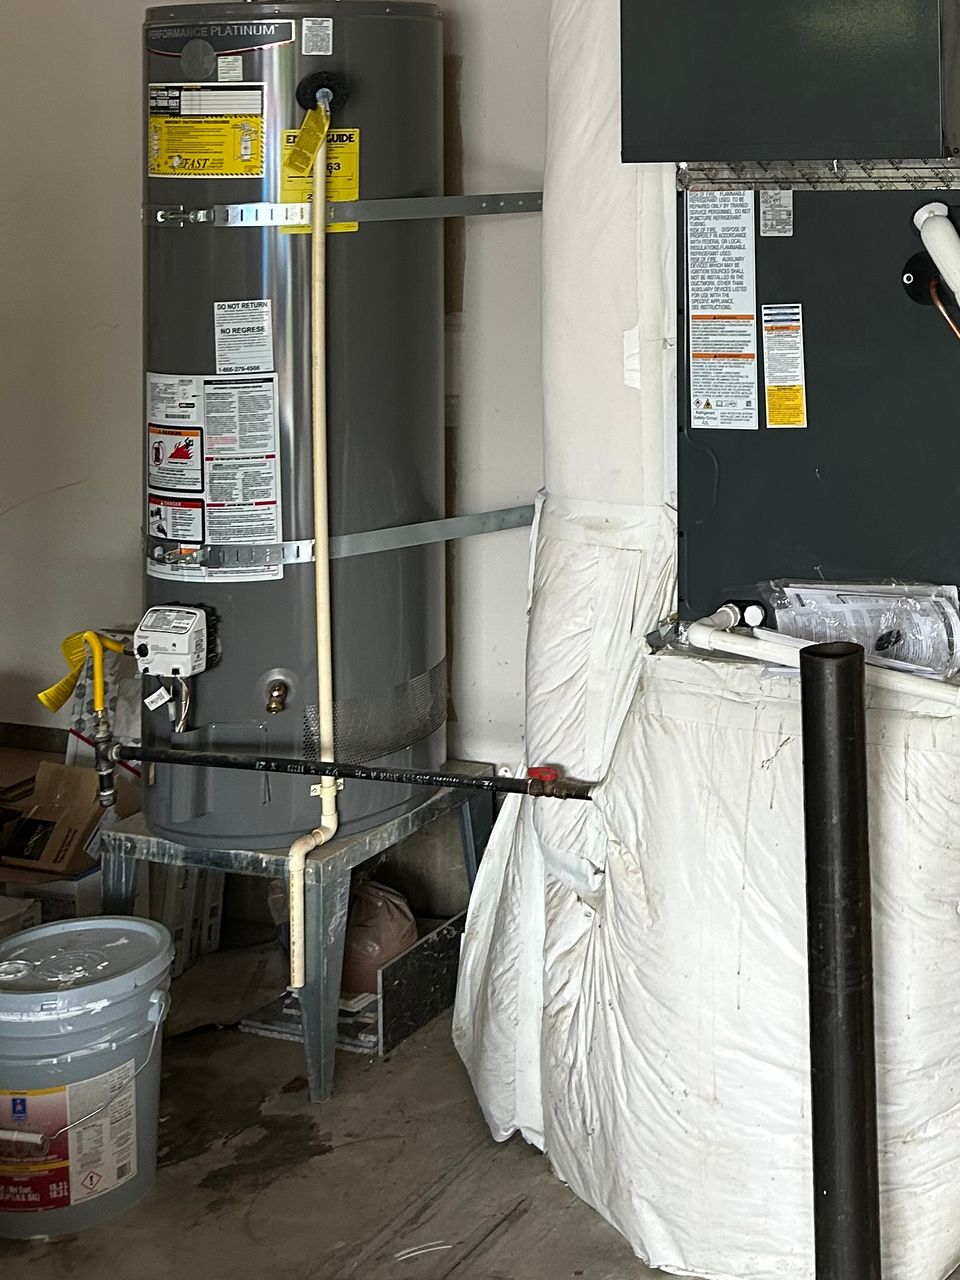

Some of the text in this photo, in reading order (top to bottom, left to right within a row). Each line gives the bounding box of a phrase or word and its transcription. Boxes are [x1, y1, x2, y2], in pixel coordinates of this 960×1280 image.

[150, 26, 208, 40] PERFORMANCE
[183, 158, 211, 169] FAST
[217, 301, 268, 311] DO NOT RETURN
[220, 325, 265, 335] NO REGRESE
